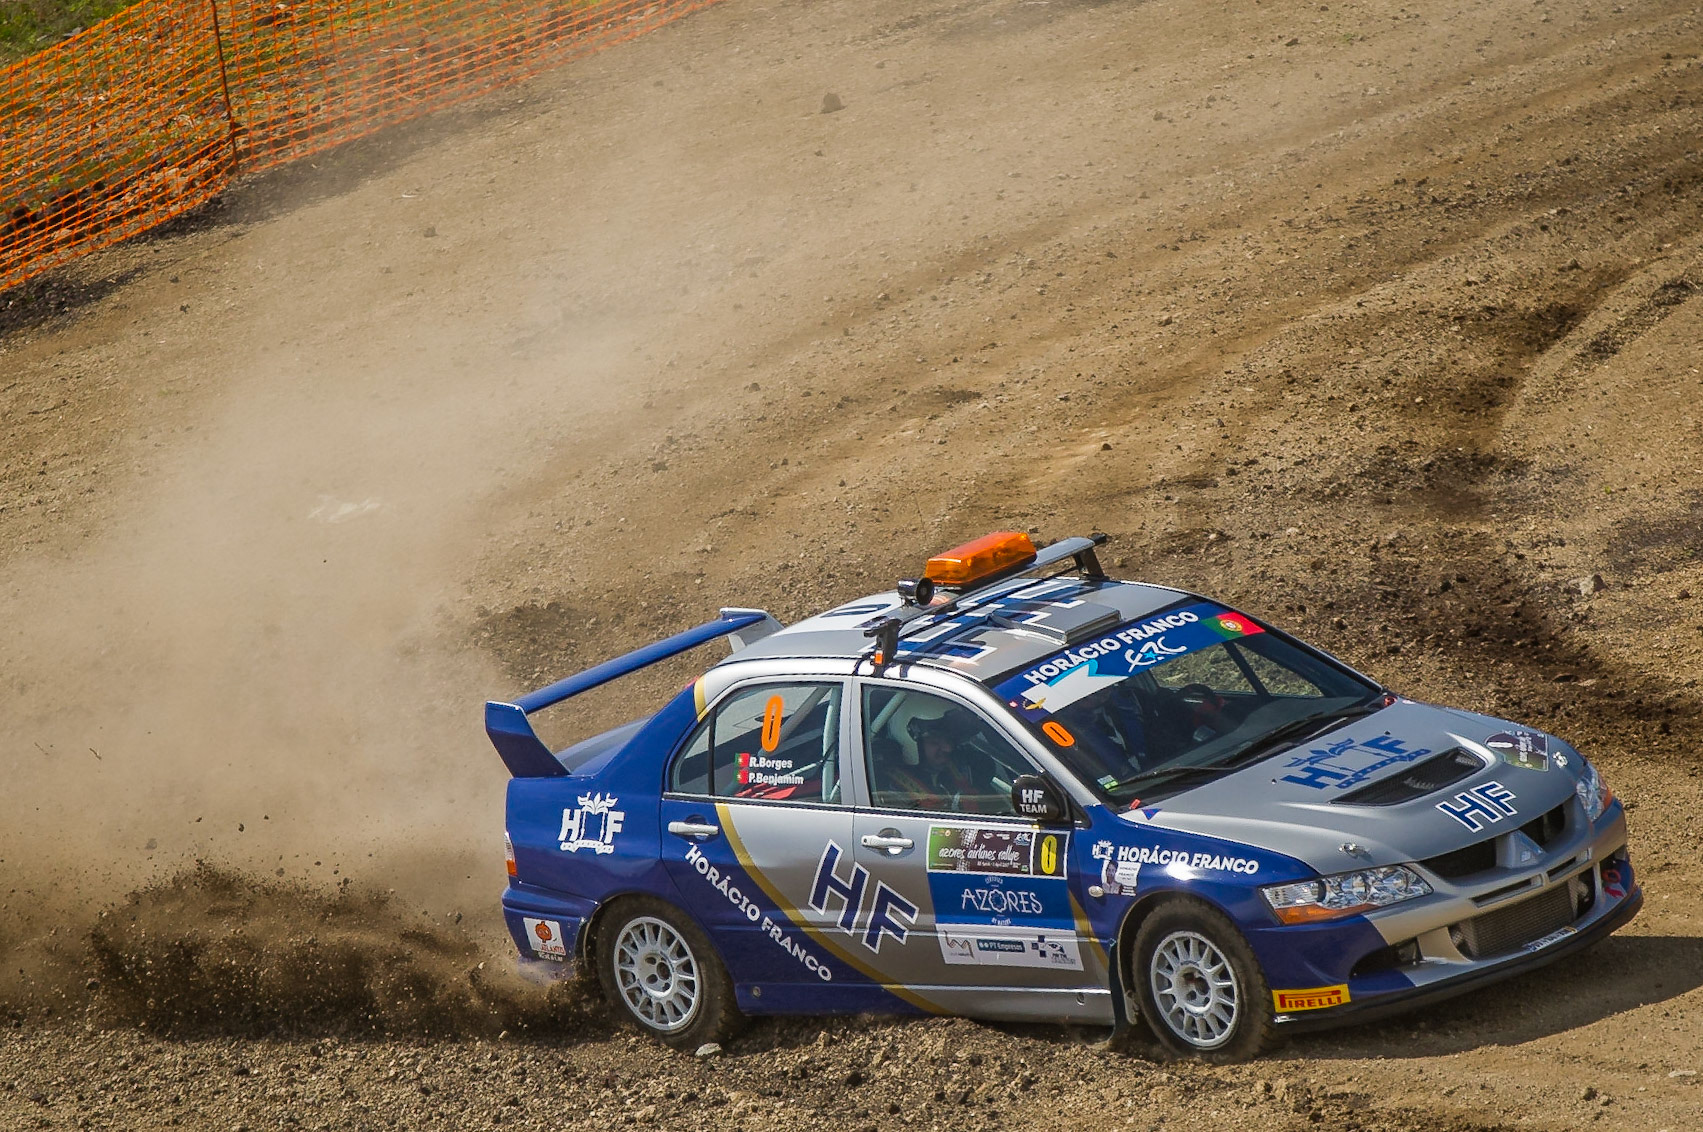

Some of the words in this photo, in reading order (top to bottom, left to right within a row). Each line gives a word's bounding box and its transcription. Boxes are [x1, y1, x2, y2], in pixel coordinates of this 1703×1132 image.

[1023, 639, 1121, 685] HORÁCIO
[1116, 611, 1199, 645] FRANCO
[761, 695, 784, 752] 0
[749, 757, 793, 770] R.Borges
[748, 772, 804, 785] P.Benjamim
[1020, 803, 1047, 814] TEAM
[1021, 789, 1044, 804] HF
[1435, 780, 1518, 833] HF
[939, 847, 966, 860] azores
[1041, 835, 1057, 875] 0
[1117, 845, 1189, 865] HORÁCIO
[1191, 853, 1259, 875] FRANCO
[808, 838, 920, 954] HF
[961, 888, 1043, 914] AZORES
[685, 845, 761, 922] HORÁCIO
[761, 916, 832, 982] FRANCO
[1278, 990, 1342, 1008] PIRELLI
